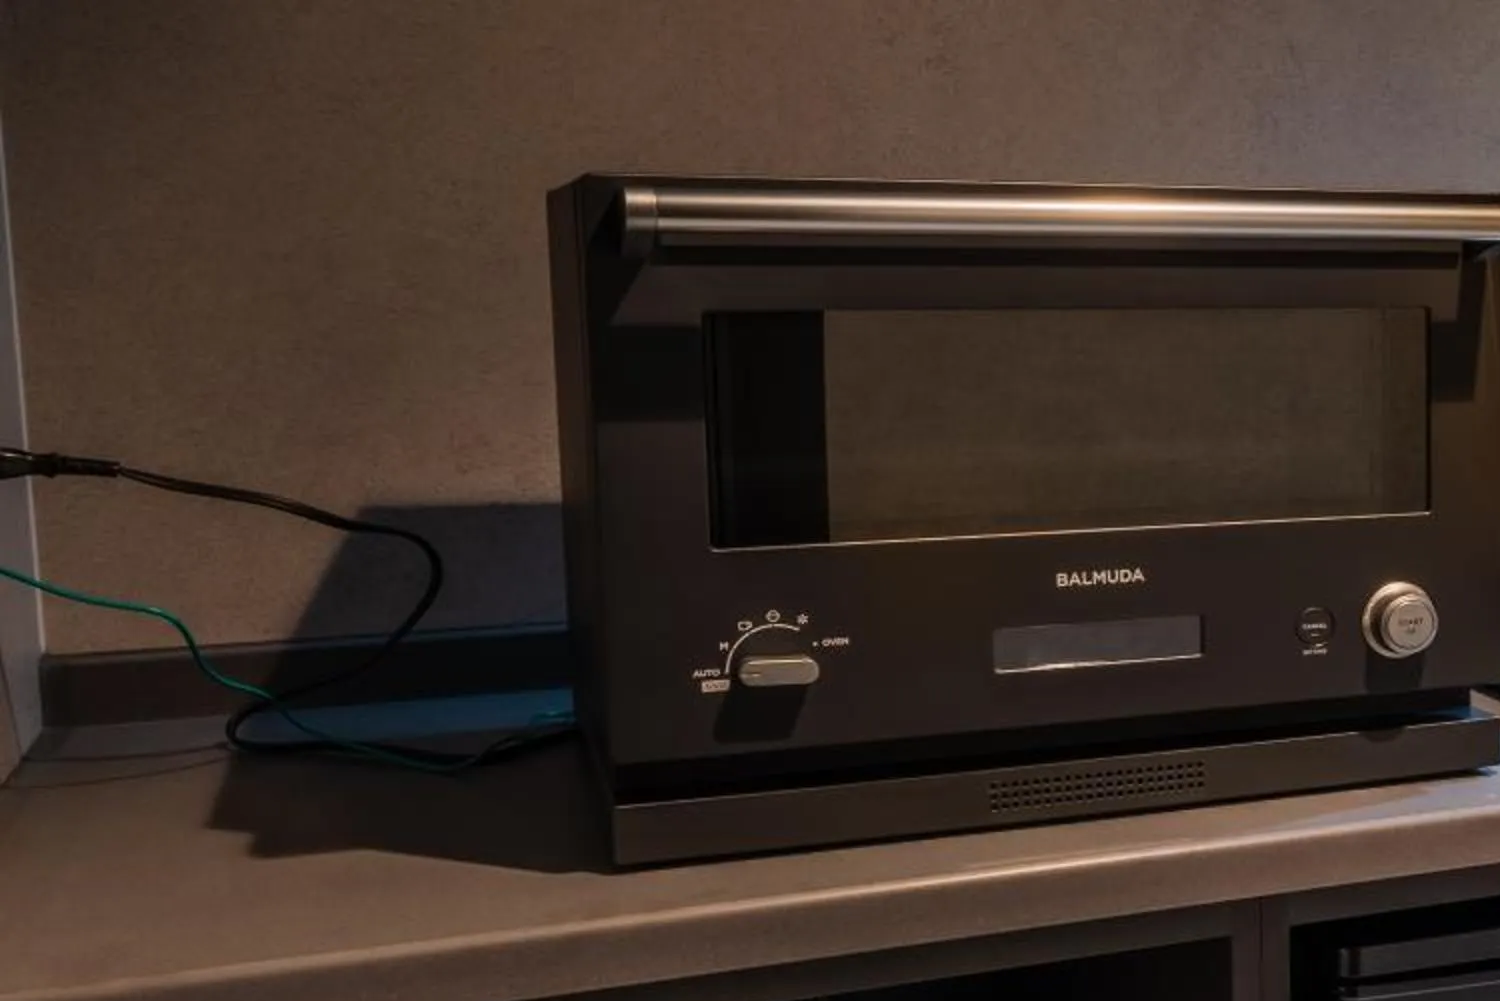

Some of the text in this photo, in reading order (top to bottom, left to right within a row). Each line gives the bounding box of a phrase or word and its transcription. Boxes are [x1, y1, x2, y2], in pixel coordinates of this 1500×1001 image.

[1055, 567, 1146, 588] BALMUDA
[821, 637, 849, 648] OVEN
[692, 668, 721, 678] AUTO
